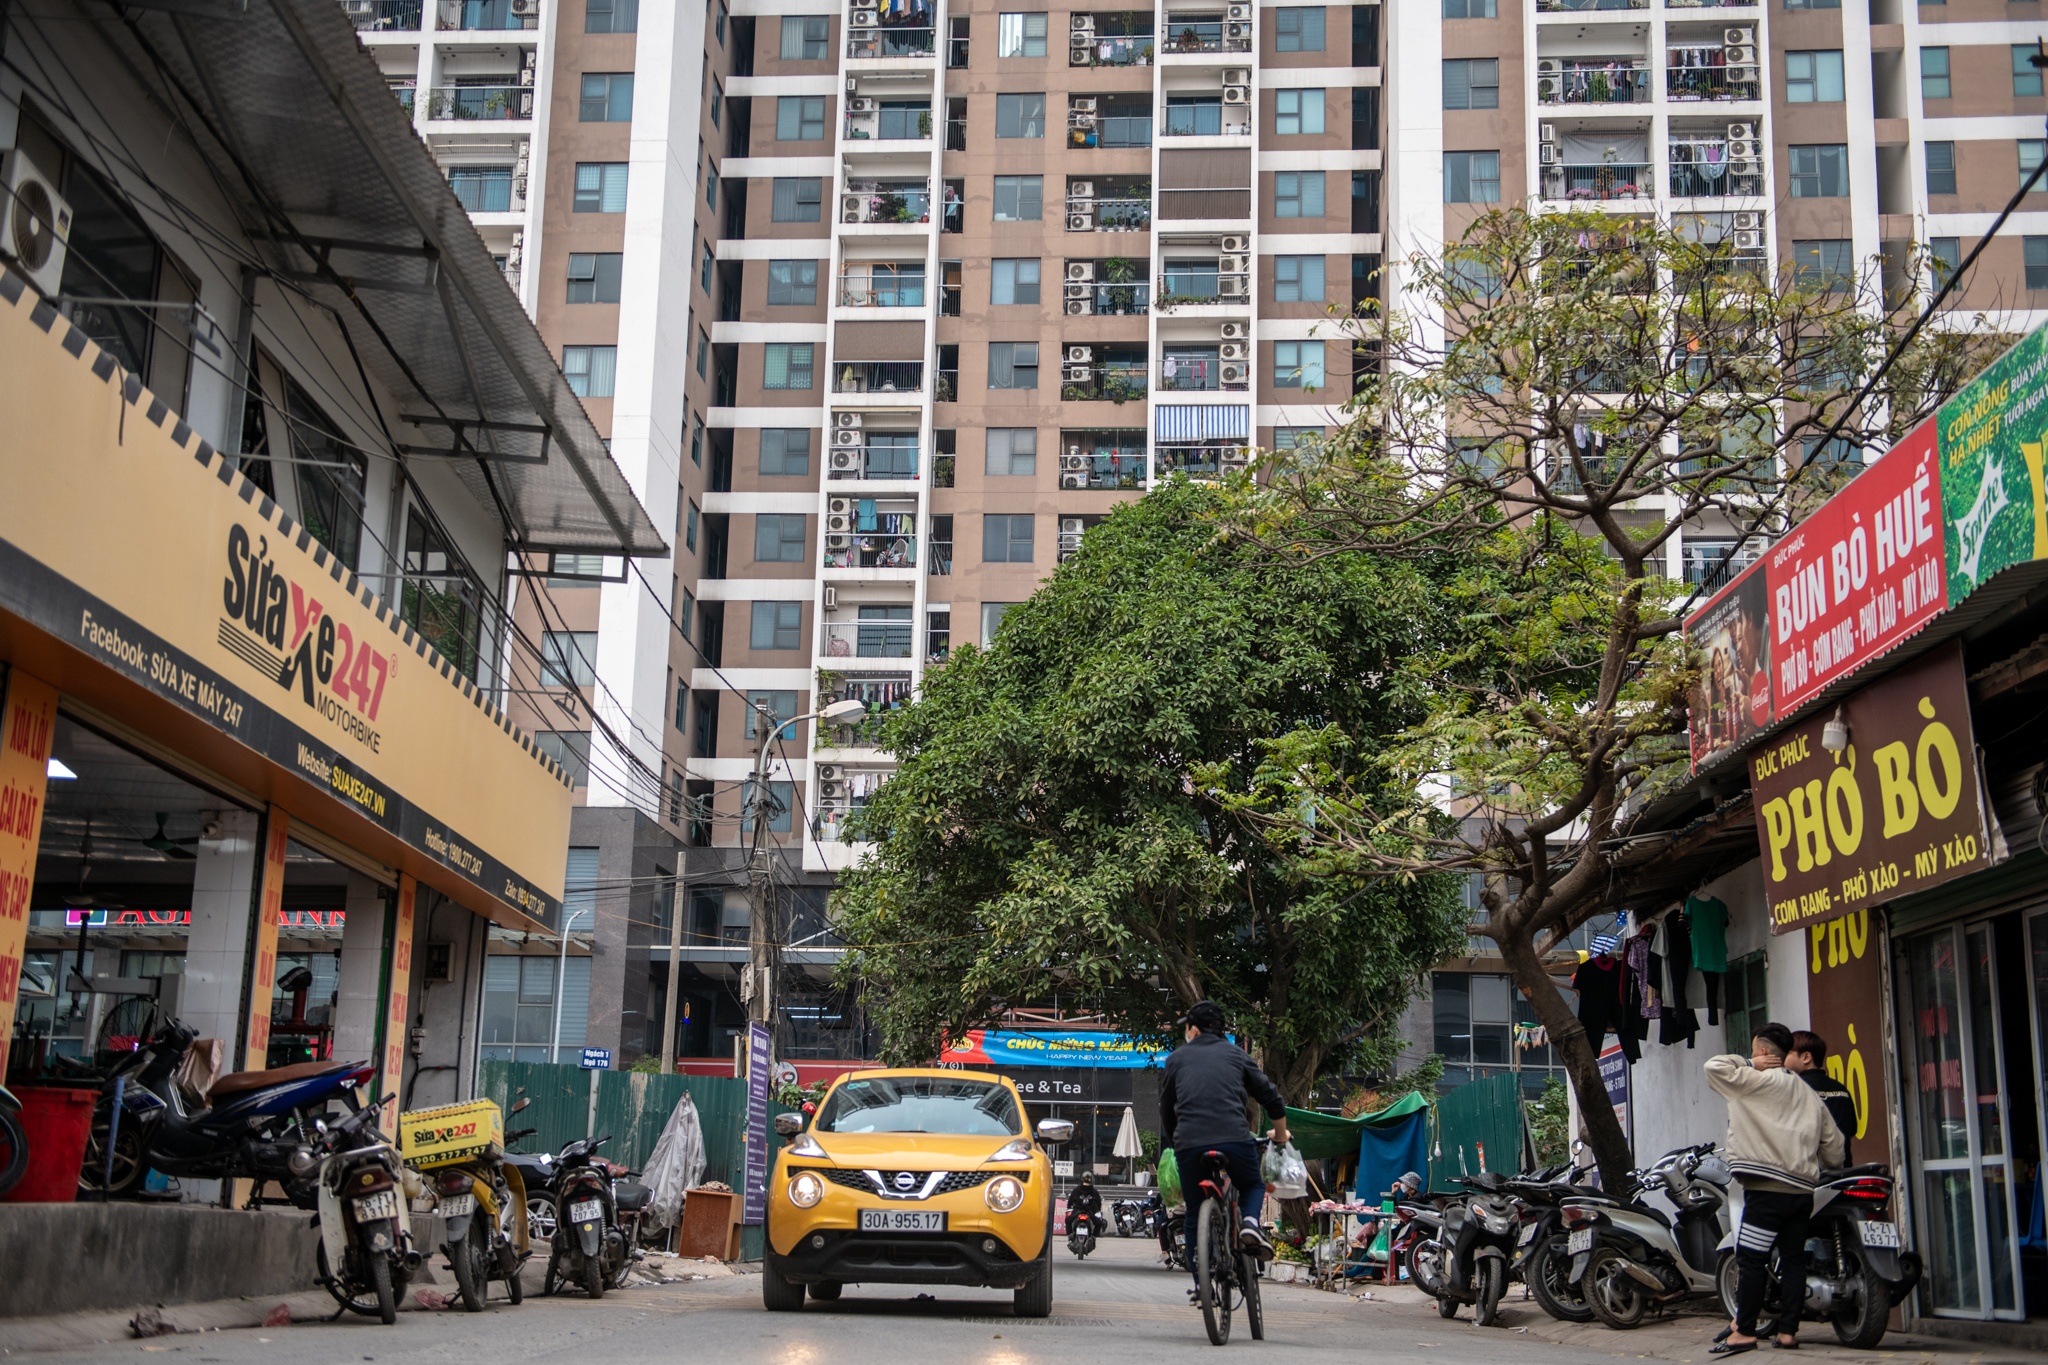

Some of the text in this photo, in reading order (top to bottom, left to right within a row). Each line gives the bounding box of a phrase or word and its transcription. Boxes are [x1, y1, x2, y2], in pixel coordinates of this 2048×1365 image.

[1949, 442, 1966, 470] HẠ
[1968, 413, 2002, 456] NHIỆT
[1775, 448, 1934, 645] BÚN BÒ HUẾ
[1787, 533, 1805, 558] PHÚC
[1962, 476, 1999, 565] Sprite
[1780, 643, 1797, 697] PHỞ
[1796, 639, 1808, 688] BÒ
[1813, 631, 1833, 677] CƠM
[1831, 616, 1855, 666] RANG
[1859, 587, 1878, 647] PHỞ
[1877, 582, 1897, 635] XÀO
[1918, 553, 1939, 608] XÀO
[81, 609, 244, 728] Facebook: SỬA XE MÁY 247
[316, 691, 381, 755] MOTORBIKE
[297, 742, 386, 818] Website: SUAXE247.VN
[1755, 733, 1810, 781] ĐỨC PHÚC
[16, 785, 38, 850] ĐẶT
[1761, 696, 1962, 882] PHỞ BÒ
[425, 827, 483, 877] Hotline: 1900.277.247
[1774, 898, 1799, 926] CƠM
[1800, 887, 1831, 917] RANG
[1842, 867, 1868, 904] PHỞ
[1870, 861, 1899, 894] XÀO
[1914, 843, 1938, 879] MỲ
[1942, 833, 1977, 869] XÀO
[9, 860, 29, 922] CẤP
[504, 878, 518, 901] Zalo:
[585, 1049, 610, 1059] Ngách 1
[1006, 1037, 1046, 1050] CHÚC
[1048, 1037, 1096, 1051] MỪNG
[1038, 1080, 1050, 1093] &
[1052, 1081, 1082, 1094] Tea
[408, 1145, 487, 1166] 1900.277.247
[361, 1205, 391, 1220] 8317
[864, 1213, 940, 1229] 30A-955.17
